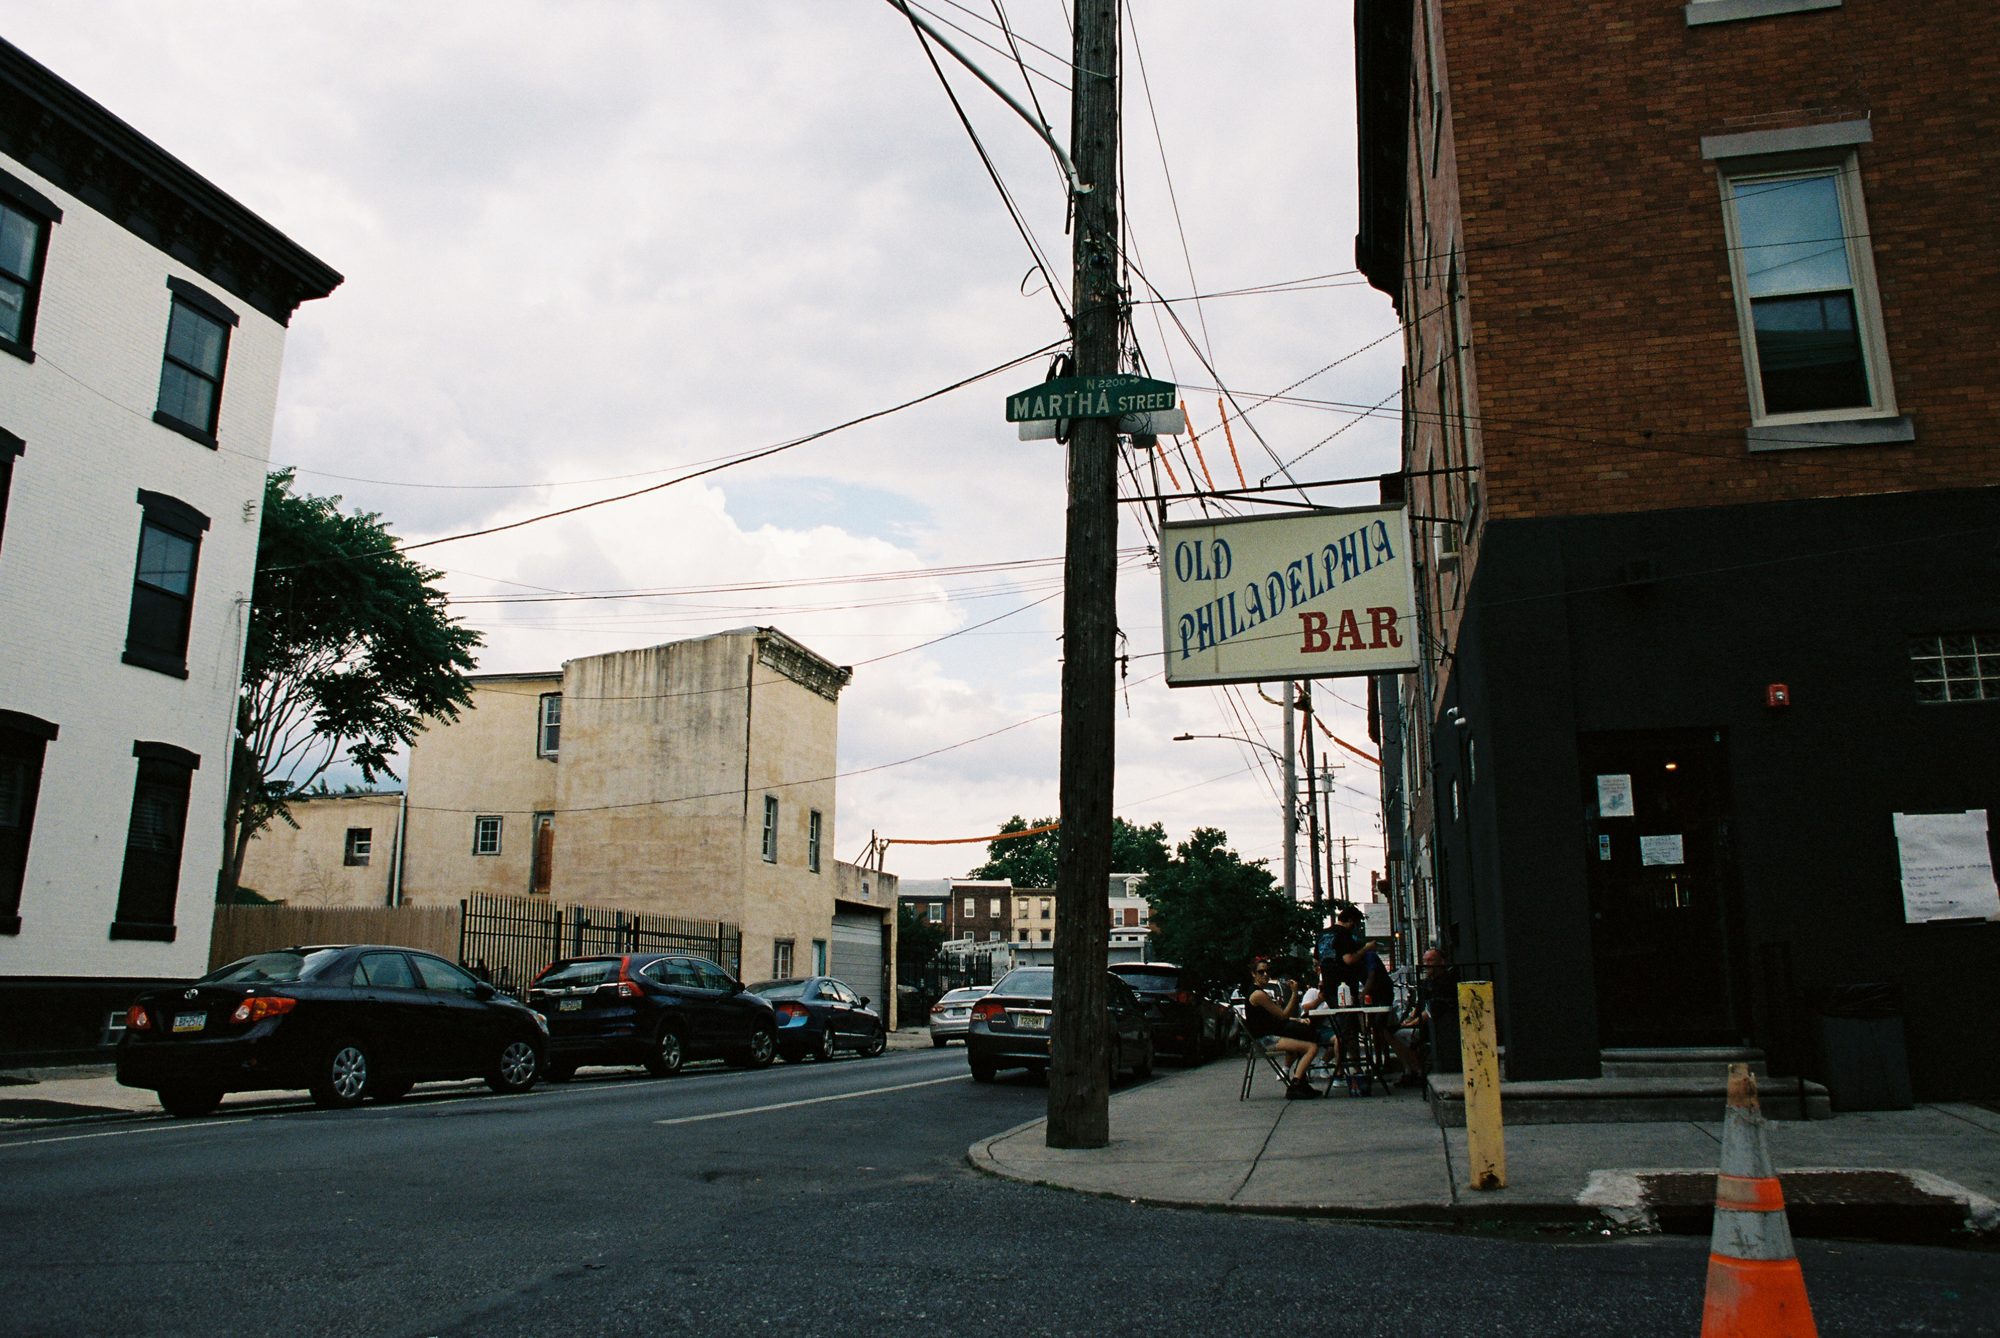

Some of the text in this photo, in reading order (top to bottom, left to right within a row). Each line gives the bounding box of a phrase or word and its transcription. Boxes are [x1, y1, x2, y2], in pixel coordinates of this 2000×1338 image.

[1013, 391, 1175, 420] MARTHA STREET
[1086, 377, 1127, 390] N 2200
[1174, 537, 1232, 583] OLD
[1177, 519, 1396, 661] PHILADELPHIA
[1298, 606, 1403, 654] BAR
